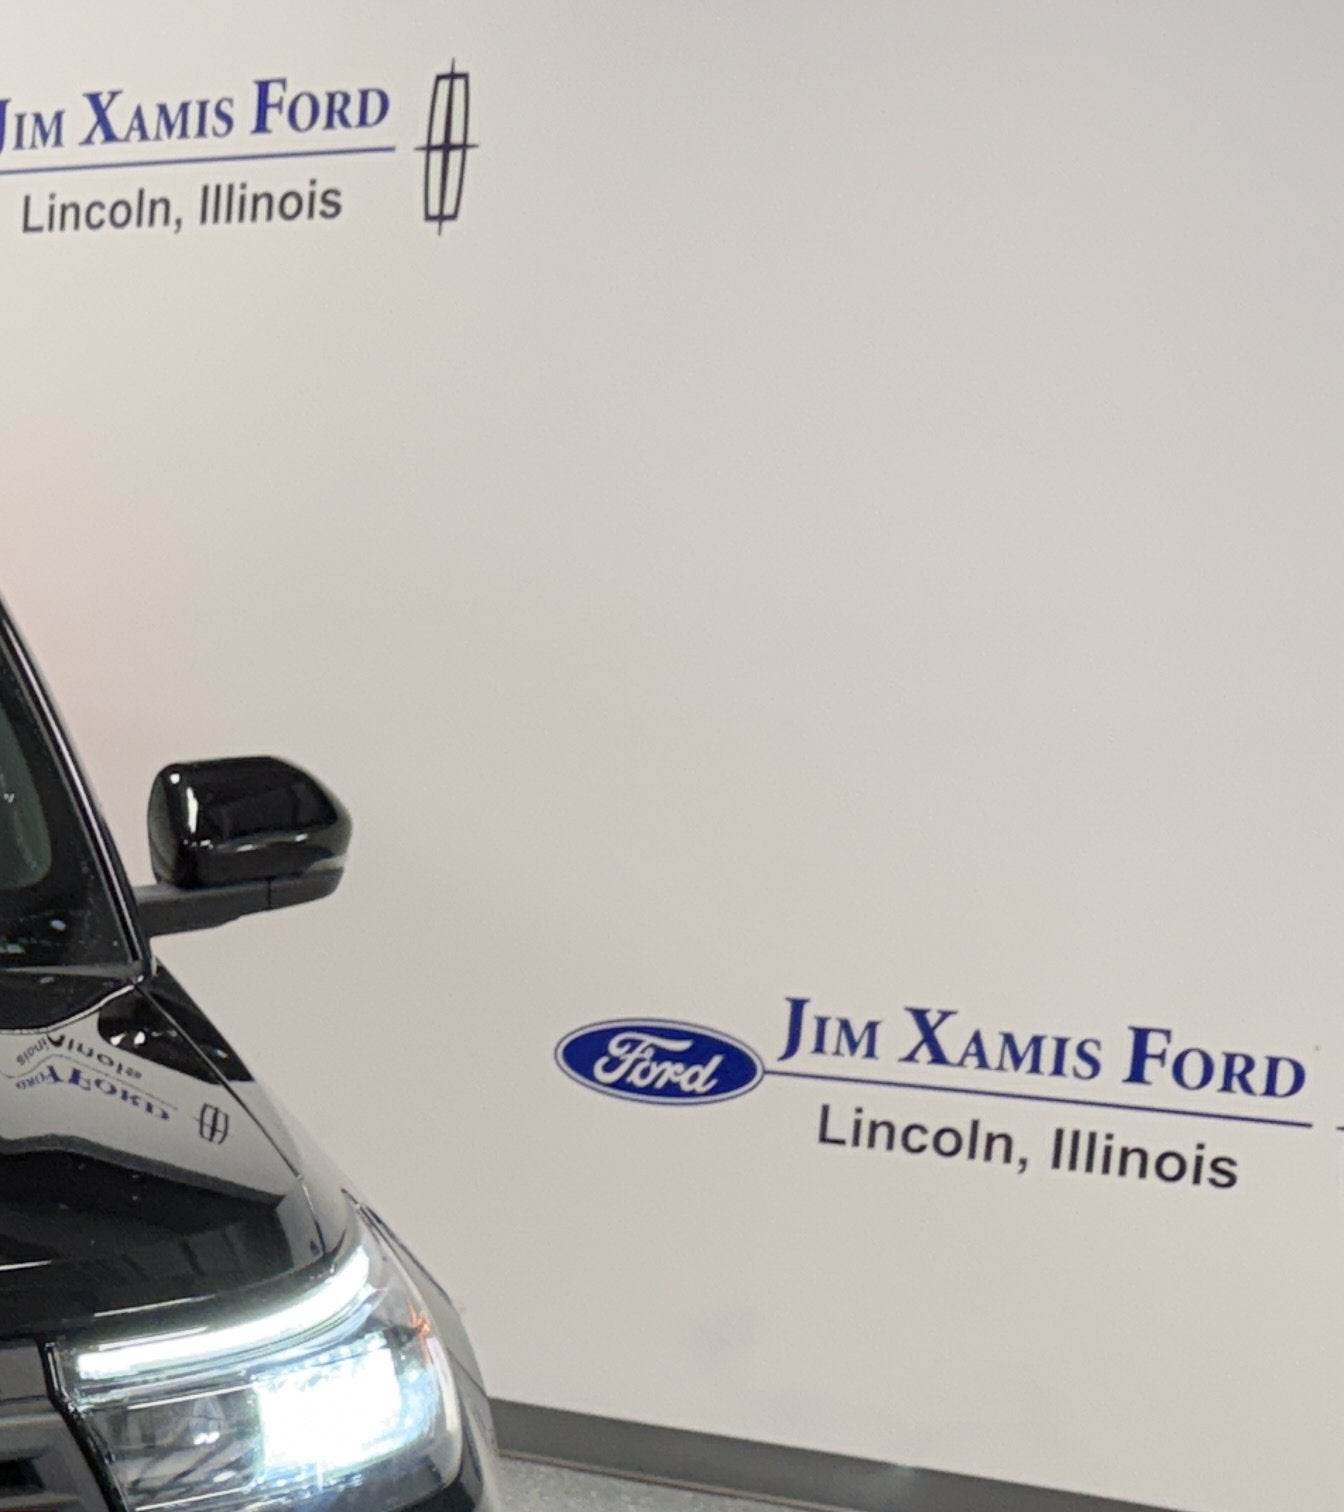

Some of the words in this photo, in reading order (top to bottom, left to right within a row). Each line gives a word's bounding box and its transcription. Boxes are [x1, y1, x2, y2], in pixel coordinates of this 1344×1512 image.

[79, 90, 234, 146] XAMIS
[251, 78, 390, 134] FORD
[22, 188, 182, 234] Lincoln,
[200, 179, 342, 225] Illinois
[593, 1031, 723, 1093] Ford
[777, 997, 881, 1062] JIM
[898, 1007, 1101, 1080] XAMIS
[1122, 1026, 1306, 1098] FORD
[818, 1104, 1028, 1173] Lincoln,
[1051, 1128, 1240, 1189] Illinois
